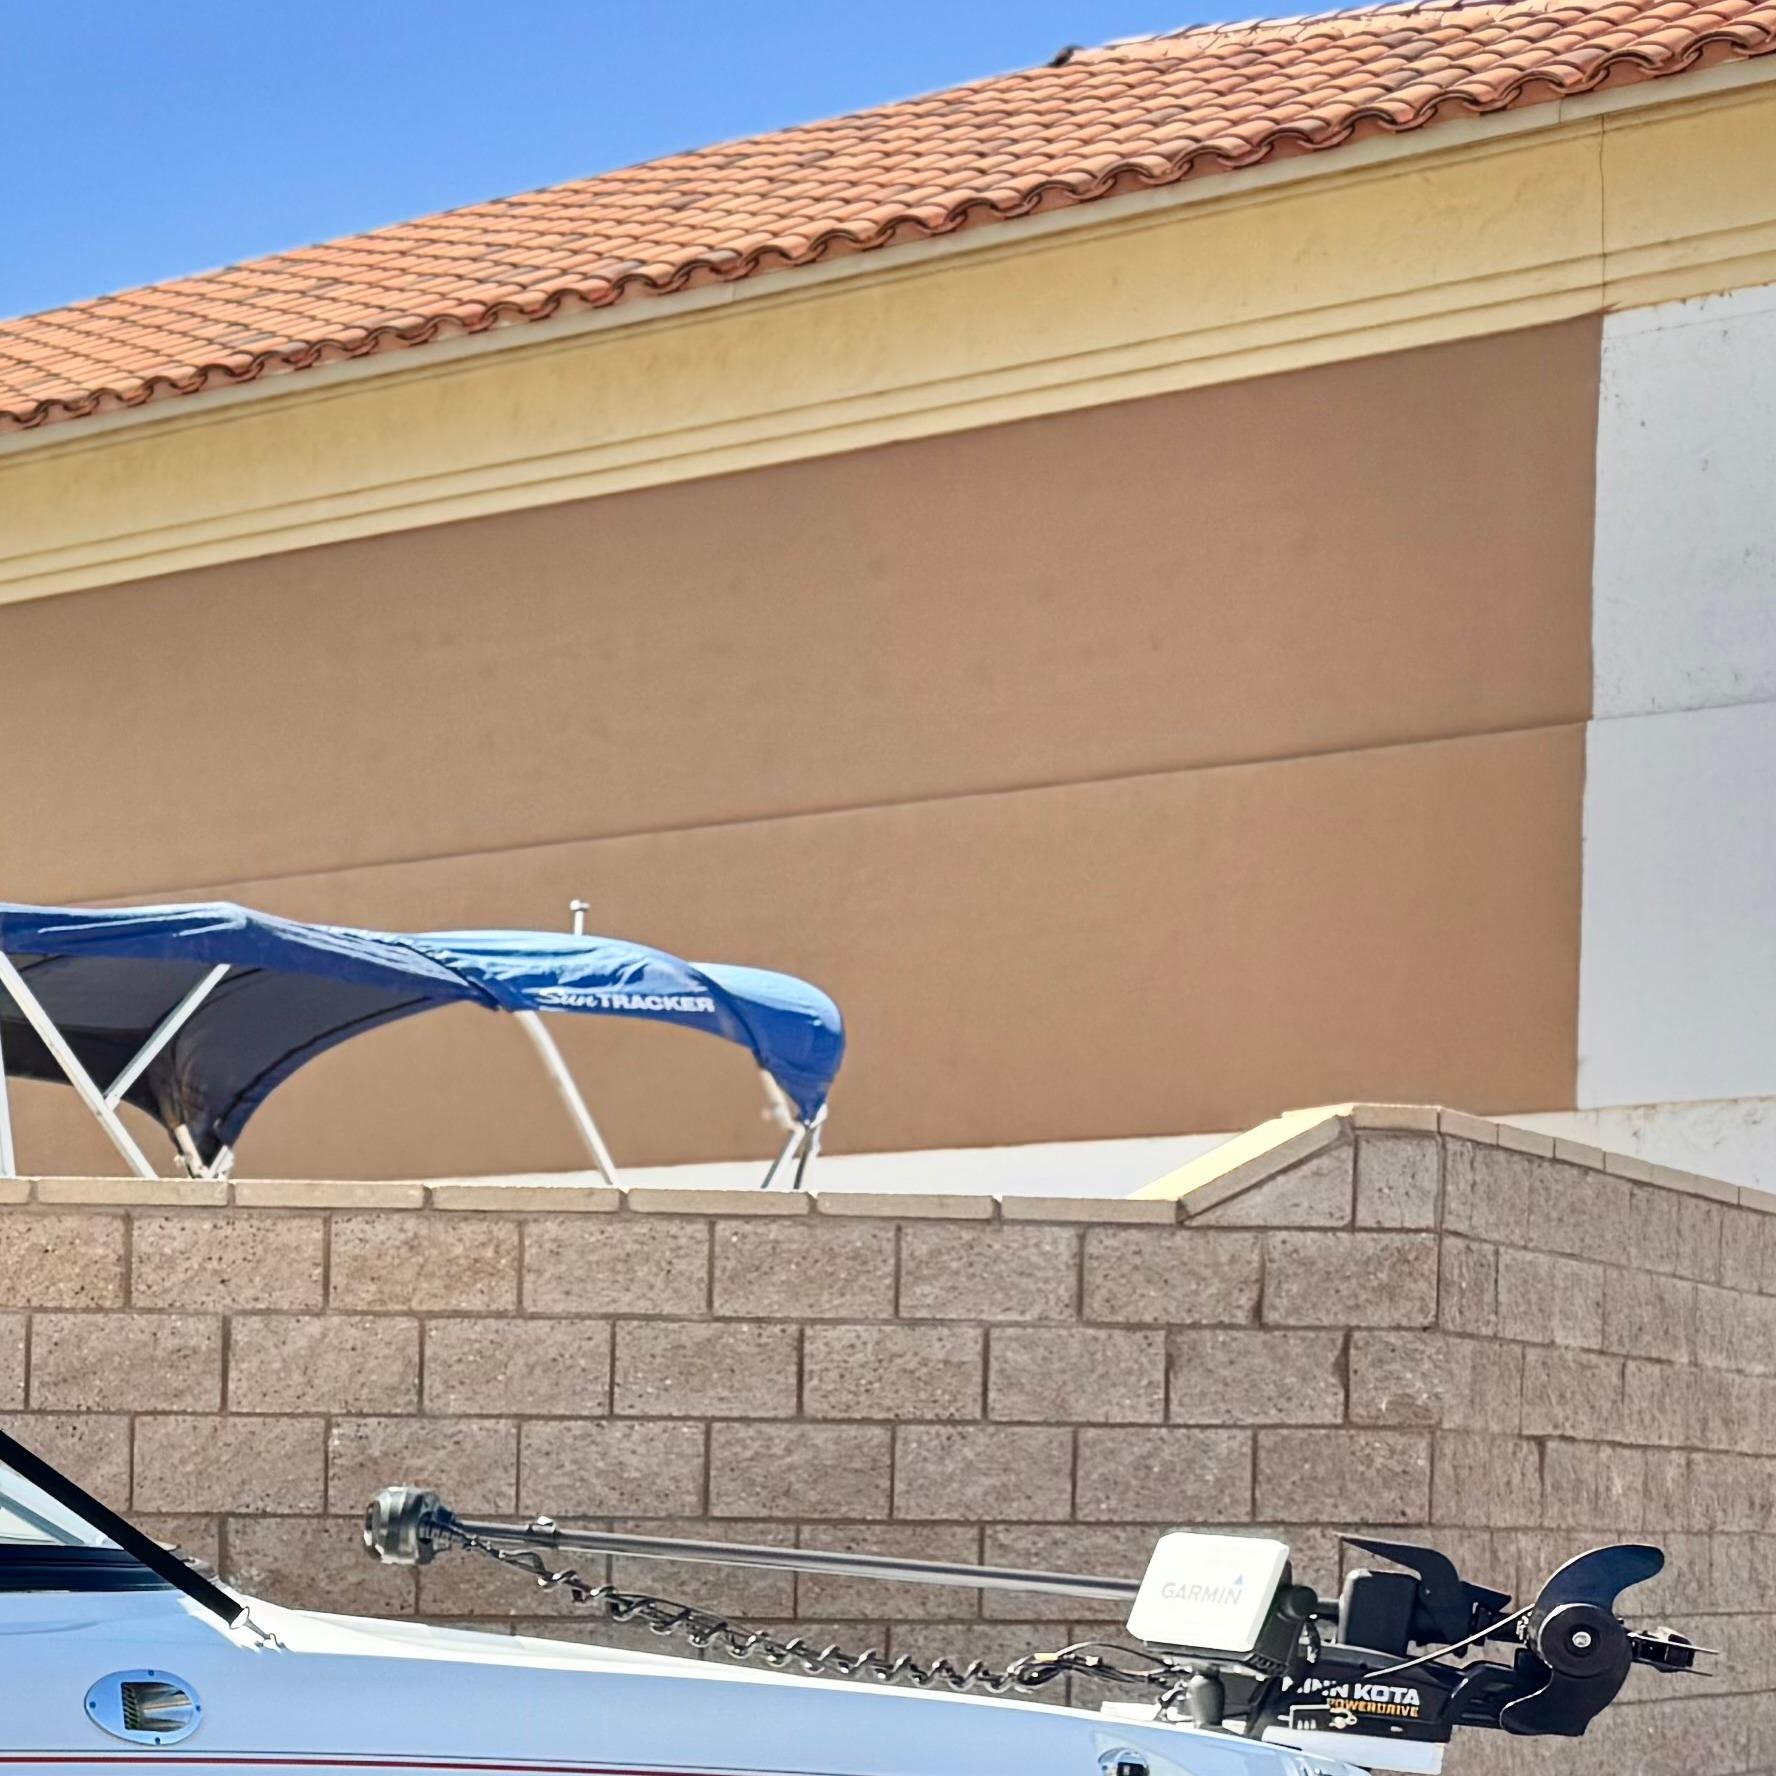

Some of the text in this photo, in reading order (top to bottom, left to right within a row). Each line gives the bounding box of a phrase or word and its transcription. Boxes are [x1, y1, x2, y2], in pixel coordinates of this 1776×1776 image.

[1160, 1582, 1243, 1605] GARMIN
[1353, 1682, 1421, 1706] KOTA
[1327, 1698, 1420, 1717] POWERDRIVE
